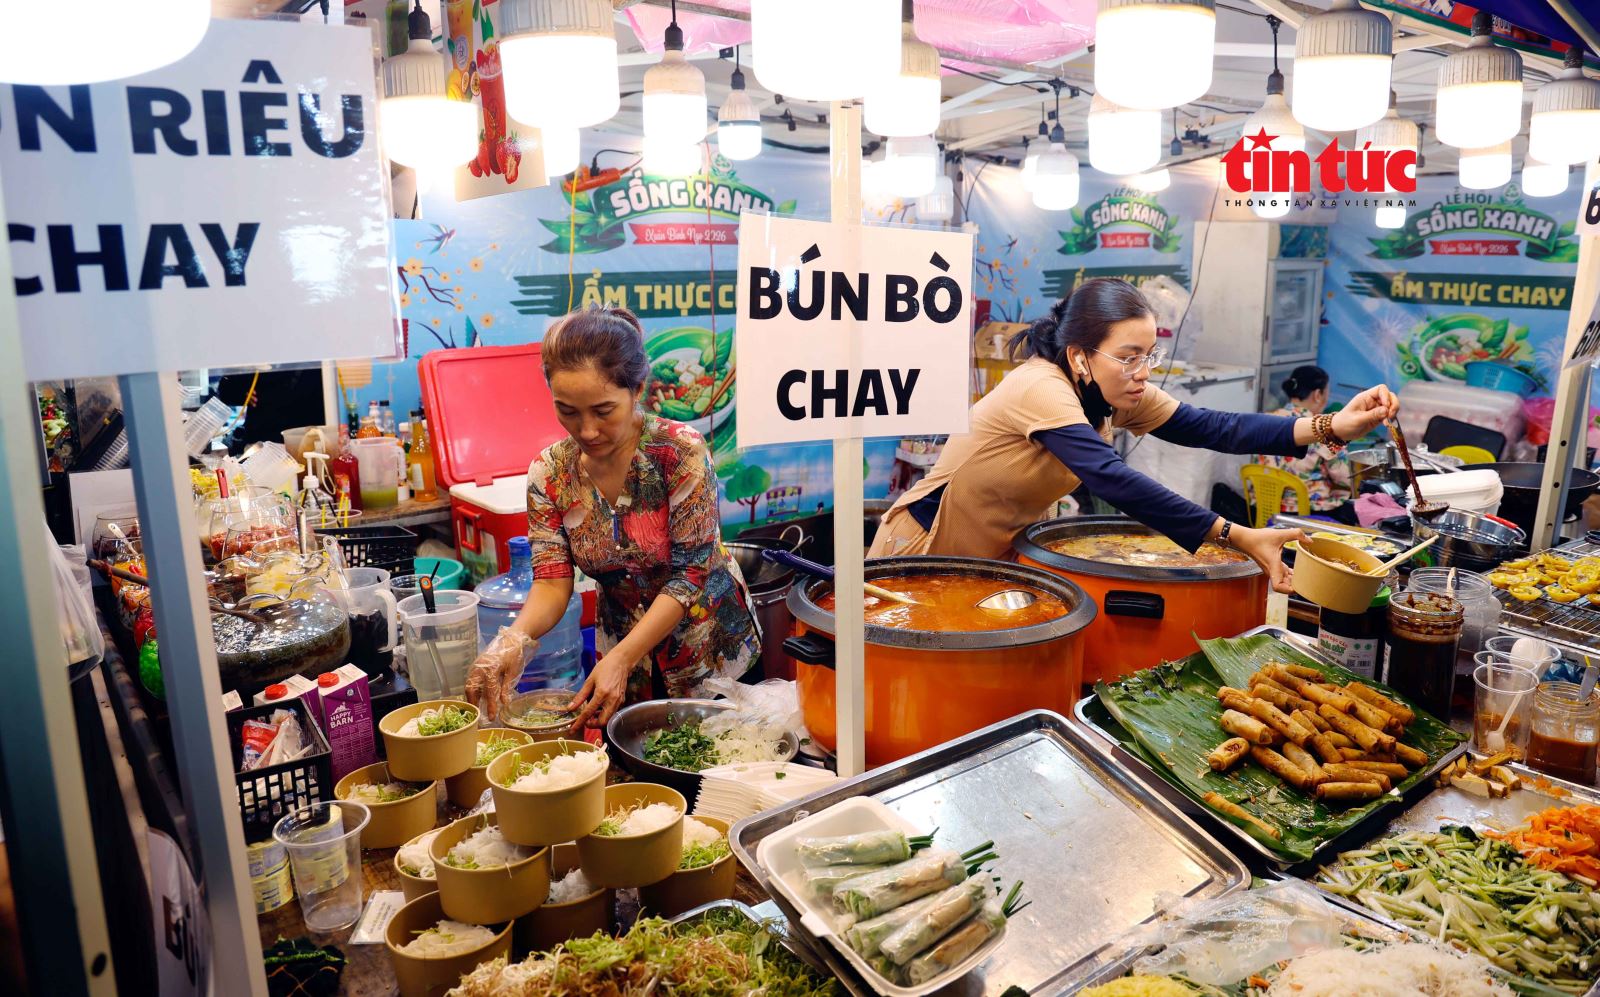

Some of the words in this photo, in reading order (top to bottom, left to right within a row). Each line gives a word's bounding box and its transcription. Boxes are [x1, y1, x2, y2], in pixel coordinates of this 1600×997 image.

[0, 84, 97, 153] N
[127, 60, 364, 158] RIÊU
[610, 171, 689, 217] SỐNG
[1092, 196, 1130, 229] SỐNG
[1131, 202, 1168, 232] XANH
[1416, 204, 1479, 237] SỐNG
[1483, 210, 1554, 240] XANH
[634, 281, 712, 317] THỰC
[749, 243, 869, 321] BÚN
[885, 251, 963, 324] BÒ
[1428, 281, 1492, 305] THỰC
[1497, 285, 1566, 307] CHAY
[776, 369, 921, 421] CHAY
[330, 710, 352, 722] HAPPY
[330, 715, 354, 729] BARN
